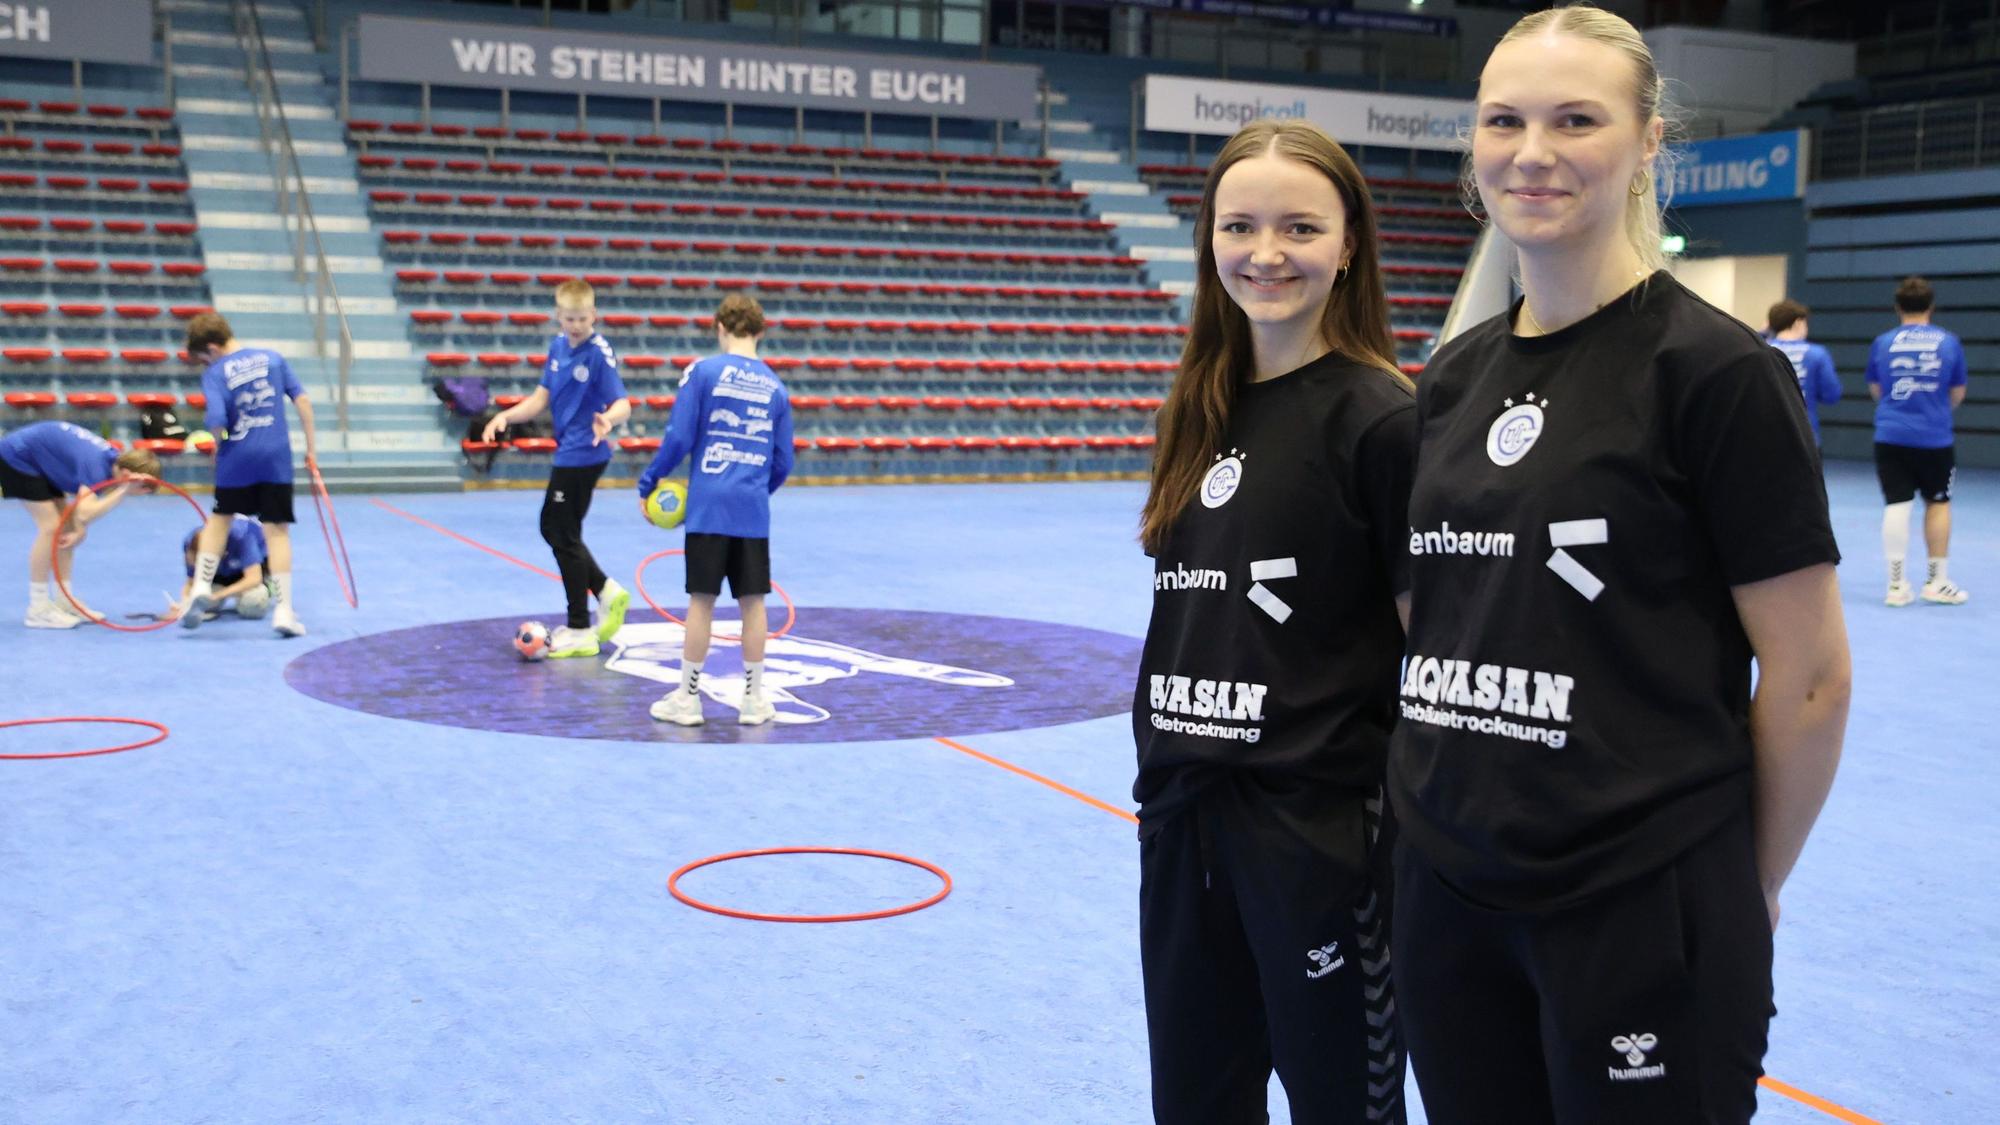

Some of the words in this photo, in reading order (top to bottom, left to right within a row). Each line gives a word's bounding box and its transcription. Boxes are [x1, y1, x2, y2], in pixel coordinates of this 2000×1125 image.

[451, 38, 536, 77] WIR
[550, 45, 706, 88] STEHEN
[720, 57, 857, 98] HINTER
[869, 69, 966, 105] EUCH
[1657, 157, 1769, 195] ITUNG
[1409, 521, 1515, 557] enbaum
[1306, 955, 1345, 979] hummel
[1608, 1062, 1665, 1080] hummel
